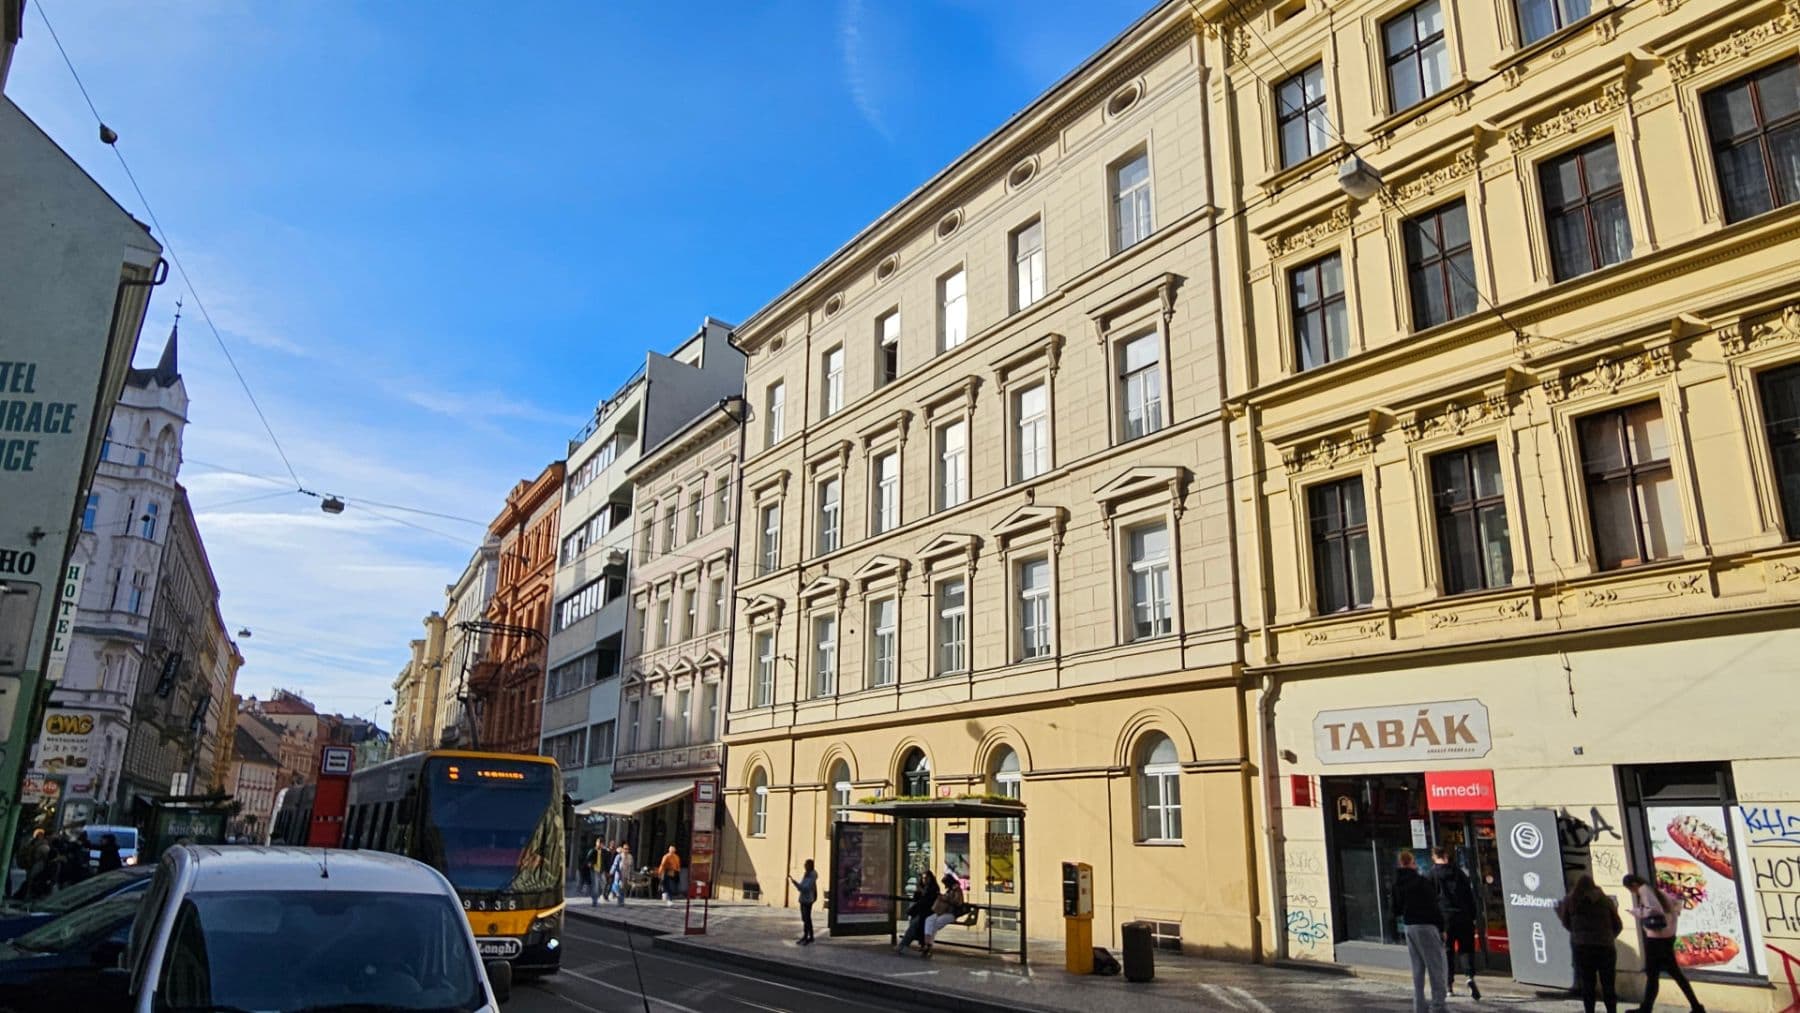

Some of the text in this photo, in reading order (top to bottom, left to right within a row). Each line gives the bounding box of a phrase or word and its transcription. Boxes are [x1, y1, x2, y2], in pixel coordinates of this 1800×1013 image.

[54, 565, 81, 653] HOTEL
[1322, 709, 1479, 751] TABÁK
[463, 900, 517, 911] 9335
